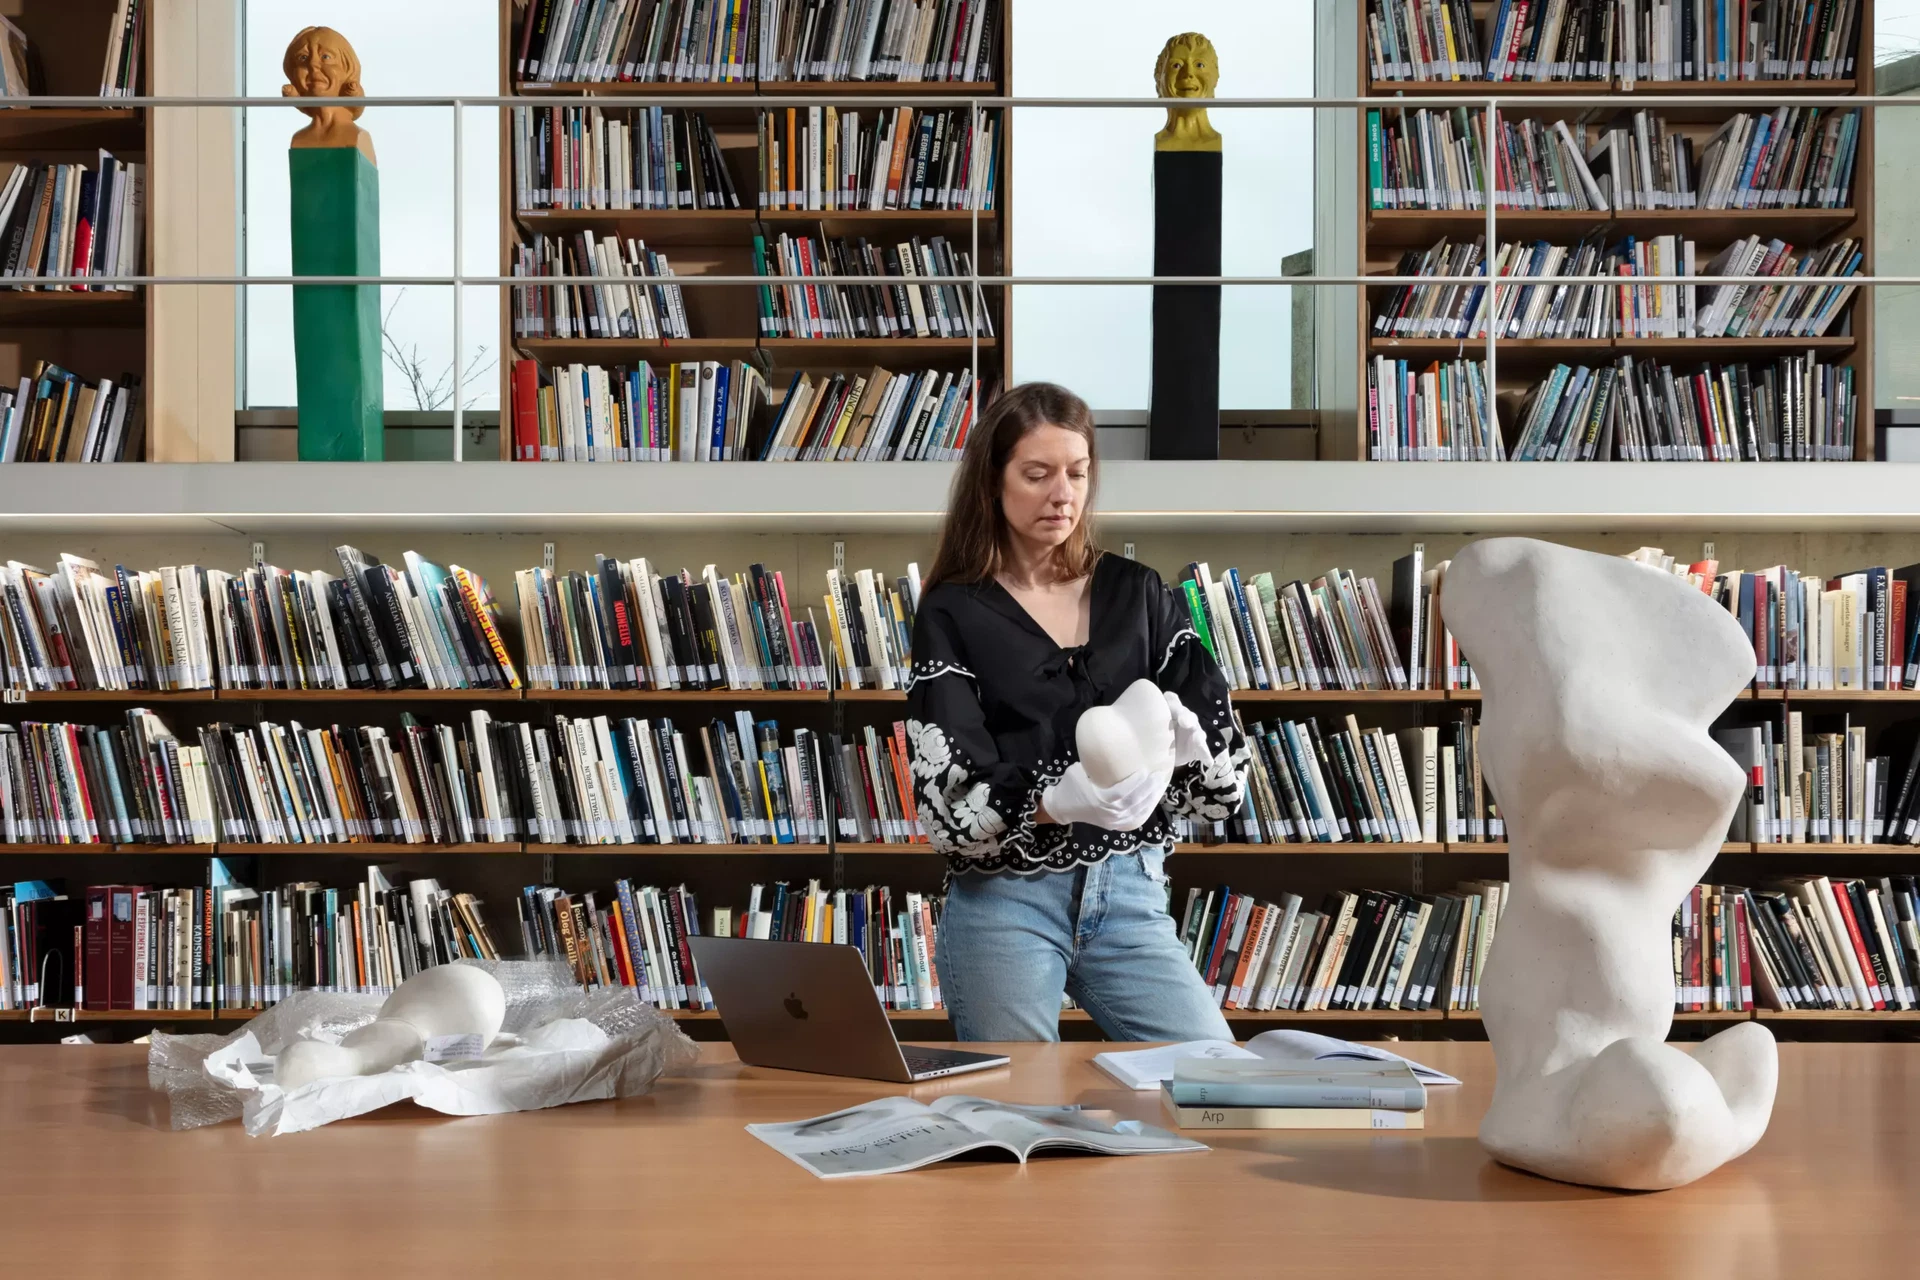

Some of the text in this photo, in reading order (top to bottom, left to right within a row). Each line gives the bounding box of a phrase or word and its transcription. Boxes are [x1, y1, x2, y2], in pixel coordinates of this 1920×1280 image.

[731, 13, 739, 28] GUST
[1433, 8, 1442, 32] ROBERT
[931, 113, 944, 162] GEORGE SEGAL
[915, 133, 929, 182] GEORGE SEGAL
[41, 177, 54, 206] RODIN
[901, 247, 912, 274] SERRA
[1468, 245, 1479, 267] STAHLY
[1749, 249, 1764, 271] THEO
[843, 384, 861, 418] SHINGU
[117, 569, 127, 597] JANNIOT
[341, 558, 356, 586] ANSELM
[352, 587, 366, 611] KIEFER
[362, 615, 370, 627] The
[110, 590, 122, 623] YANNICK VU
[167, 586, 180, 623] OSCAR
[384, 590, 410, 649] ANSELM KIEFER
[830, 576, 846, 629] BERTO LARDERA
[1893, 585, 1901, 621] MESSINA
[406, 621, 420, 647] KIEFER
[612, 600, 631, 646] KOUNELLIS
[1843, 621, 1851, 651] Messager
[1876, 589, 1884, 661] MESSERSCHMIDT
[14, 692, 20, 700] J
[575, 724, 593, 789] BERLIN KRIESTER
[641, 726, 652, 764] Rainer Kriester
[660, 727, 670, 751] Rainer
[1305, 743, 1313, 760] MACK
[23, 735, 36, 783] ALLEN JONES
[626, 735, 643, 788] Rainer Kriester
[664, 752, 675, 779] Kriester
[796, 734, 811, 798] GARY KUEHN FIVE
[1294, 749, 1311, 784] Magritte
[1366, 746, 1385, 791] MAILLOL
[1388, 740, 1407, 790] MAILLOL
[523, 742, 544, 818] WILLY KREITZ
[608, 767, 618, 792] Kriester
[1425, 751, 1435, 812] MAILLOL
[668, 894, 676, 916] HANS
[1273, 912, 1281, 925] Mark
[1342, 906, 1352, 922] MAN
[1373, 898, 1387, 924] Man Ray
[1395, 898, 1403, 910] MAN
[1486, 902, 1496, 929] Sculpture
[136, 905, 145, 981] THE EXPERIMENTAL GROUP
[558, 910, 577, 965] Oleg Kulik
[624, 910, 644, 977] YAYOI KUSAMA
[661, 899, 677, 959] Raimund Kummer On
[911, 900, 920, 924] Atelier
[916, 941, 927, 972] Lieshout
[1241, 908, 1263, 963] MARK MANDERS
[1253, 906, 1274, 956] MARK MANDERS
[1276, 925, 1298, 976] MARK MANDERS
[58, 1010, 65, 1019] K
[1202, 1110, 1224, 1124] Arp
[820, 1146, 867, 1157] Arp
[875, 1125, 945, 1148] Hans
